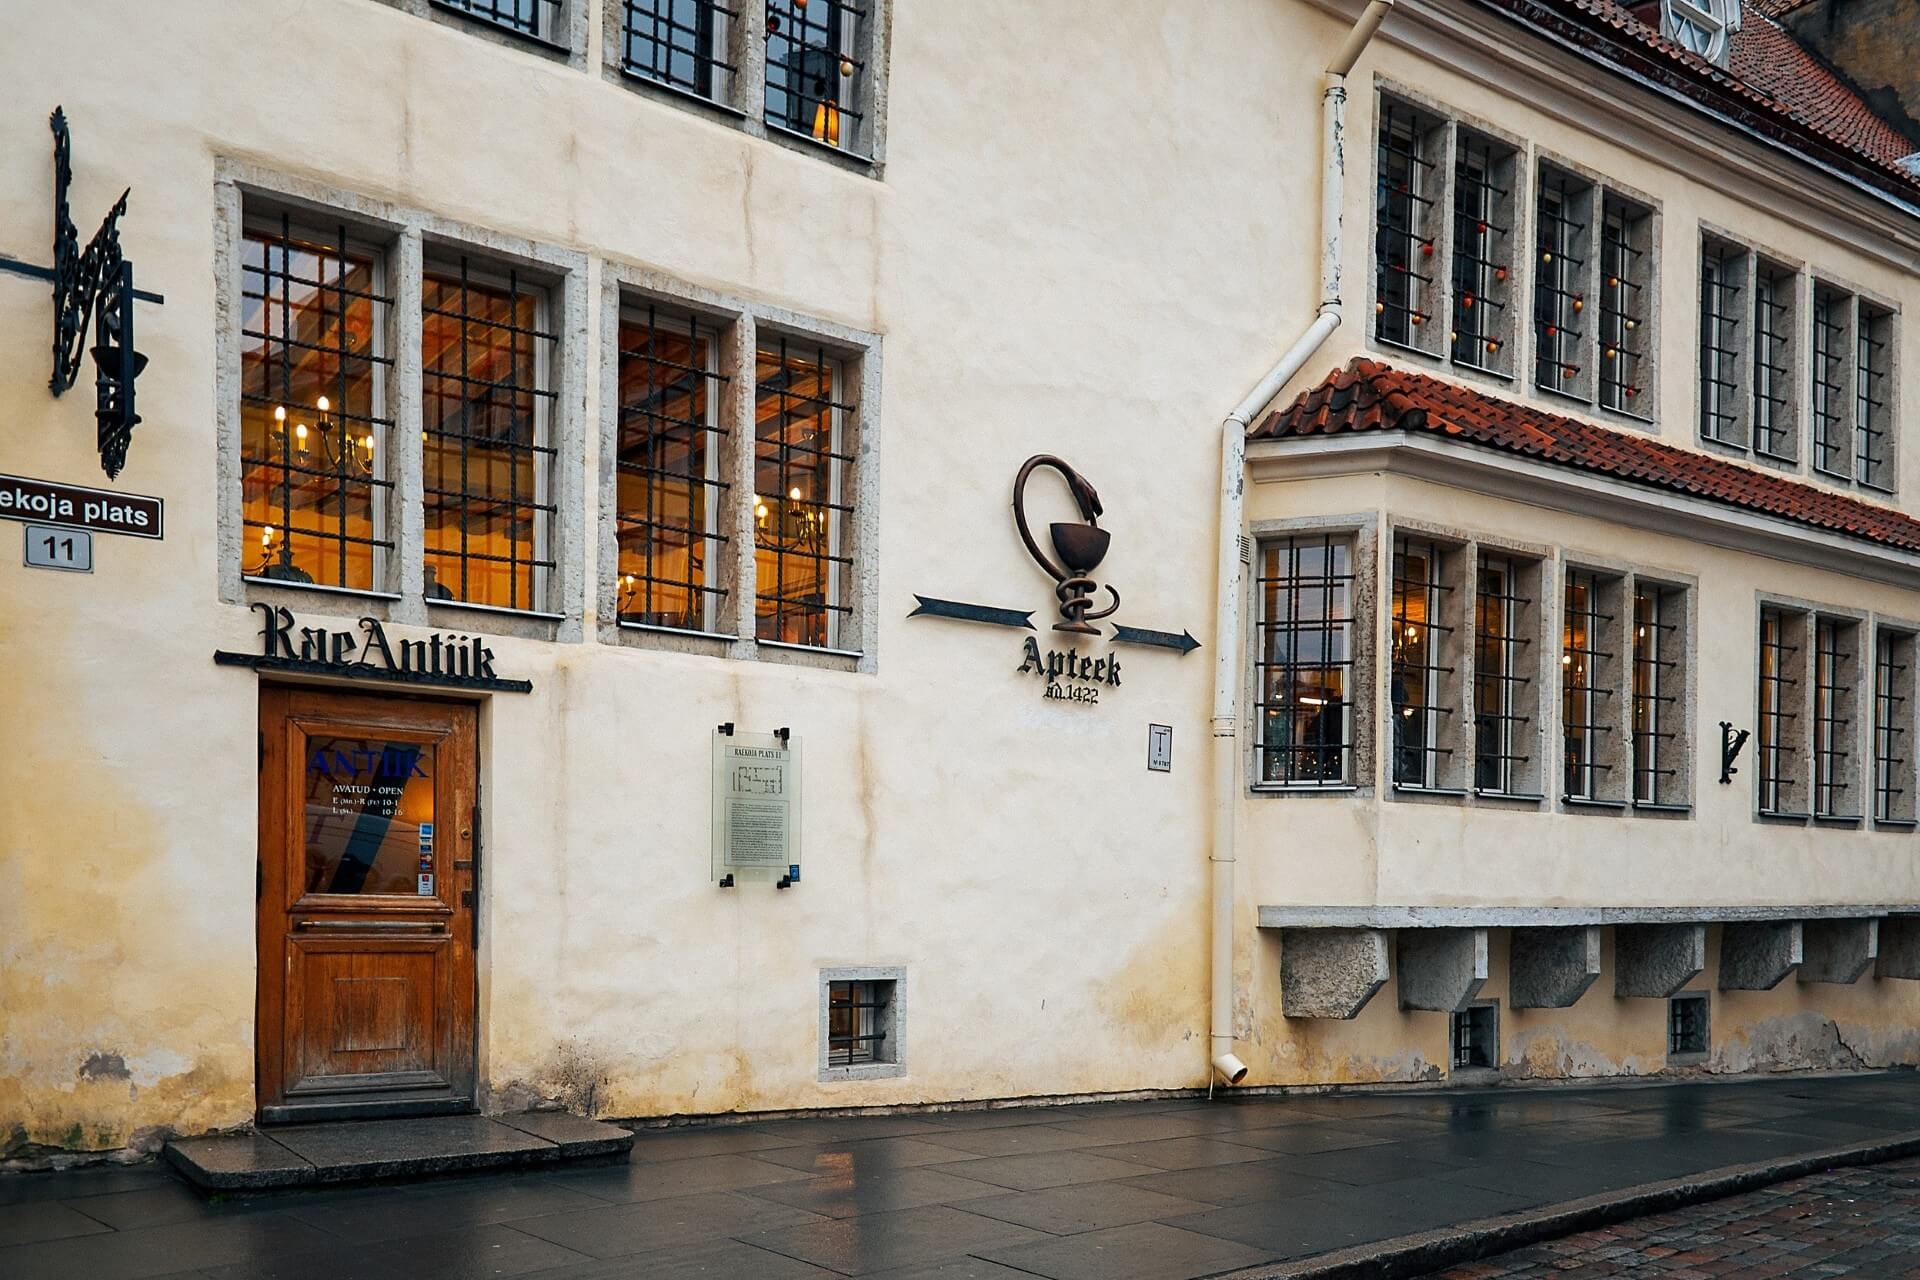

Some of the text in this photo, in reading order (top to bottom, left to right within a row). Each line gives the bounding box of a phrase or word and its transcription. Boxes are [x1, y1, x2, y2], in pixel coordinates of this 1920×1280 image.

[0, 488, 149, 527] ekoja plats
[43, 536, 73, 561] 11
[1017, 636, 1121, 687] Apteek
[758, 750, 775, 759] PLATS
[332, 784, 404, 795] AVATUD OPEN
